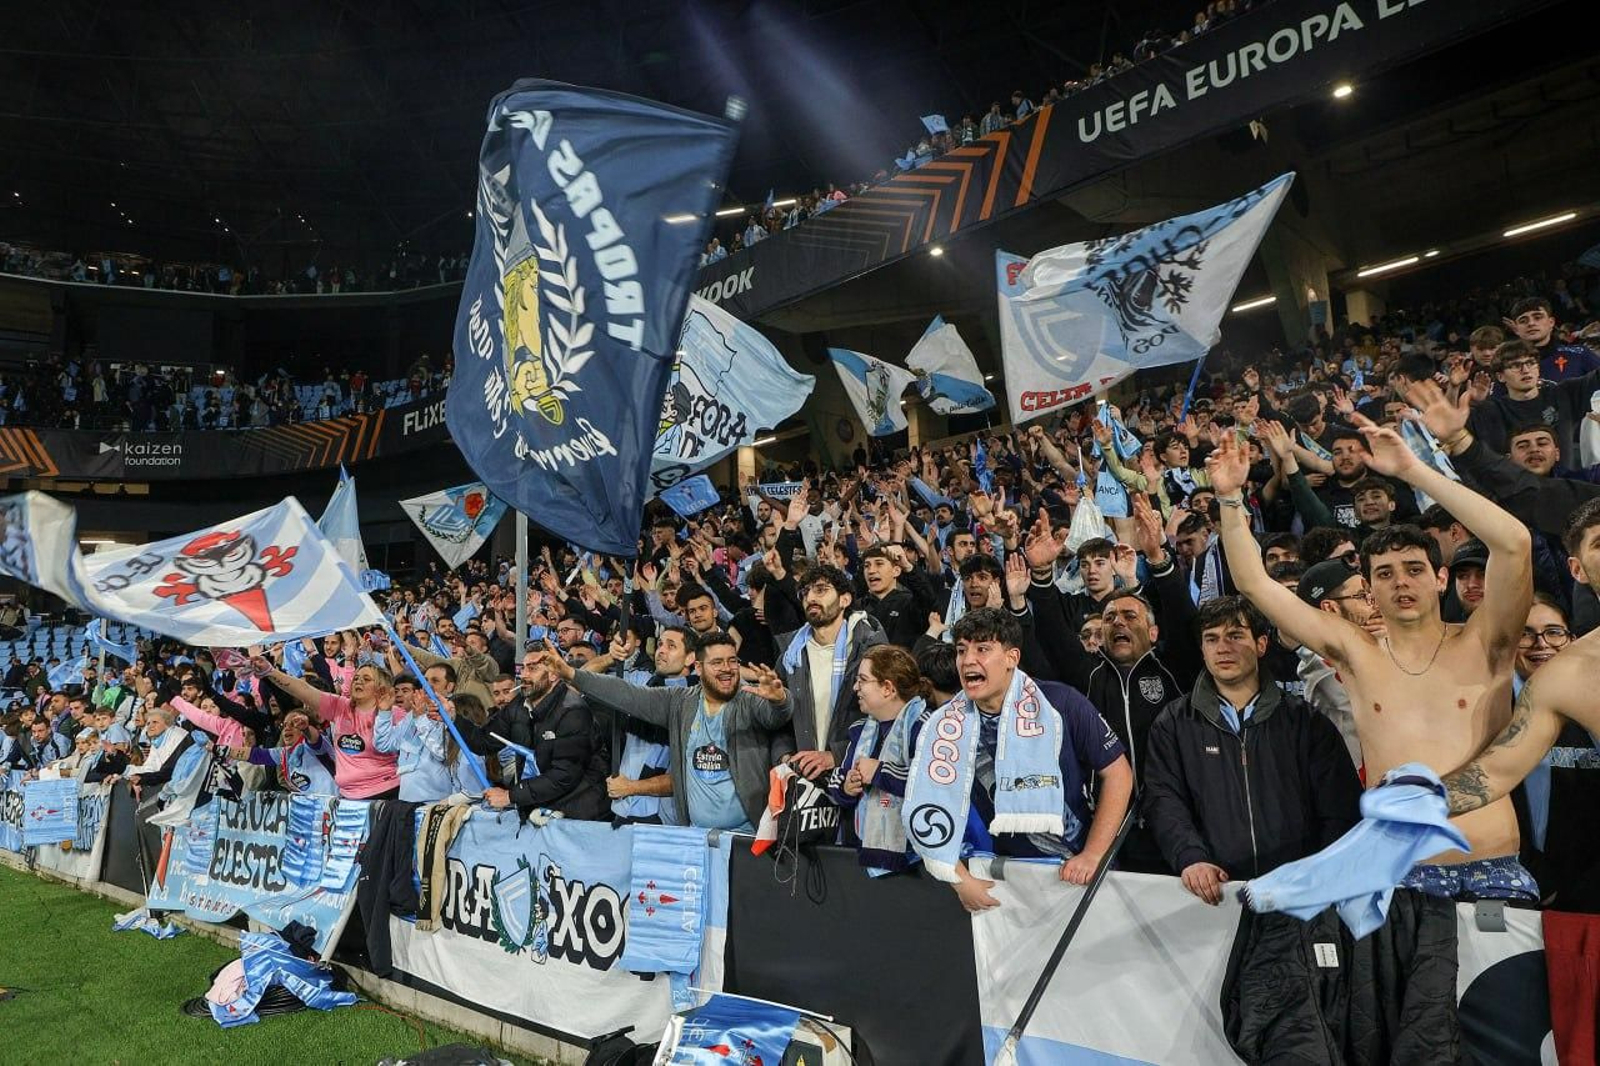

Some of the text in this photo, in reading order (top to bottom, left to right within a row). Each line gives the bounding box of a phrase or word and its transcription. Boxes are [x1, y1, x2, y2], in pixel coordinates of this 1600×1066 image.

[1078, 83, 1176, 144] UEFA
[1186, 3, 1365, 101] EUROPA
[124, 441, 183, 457] kaizen
[124, 455, 182, 467] foundation
[209, 838, 287, 893] ELESTES
